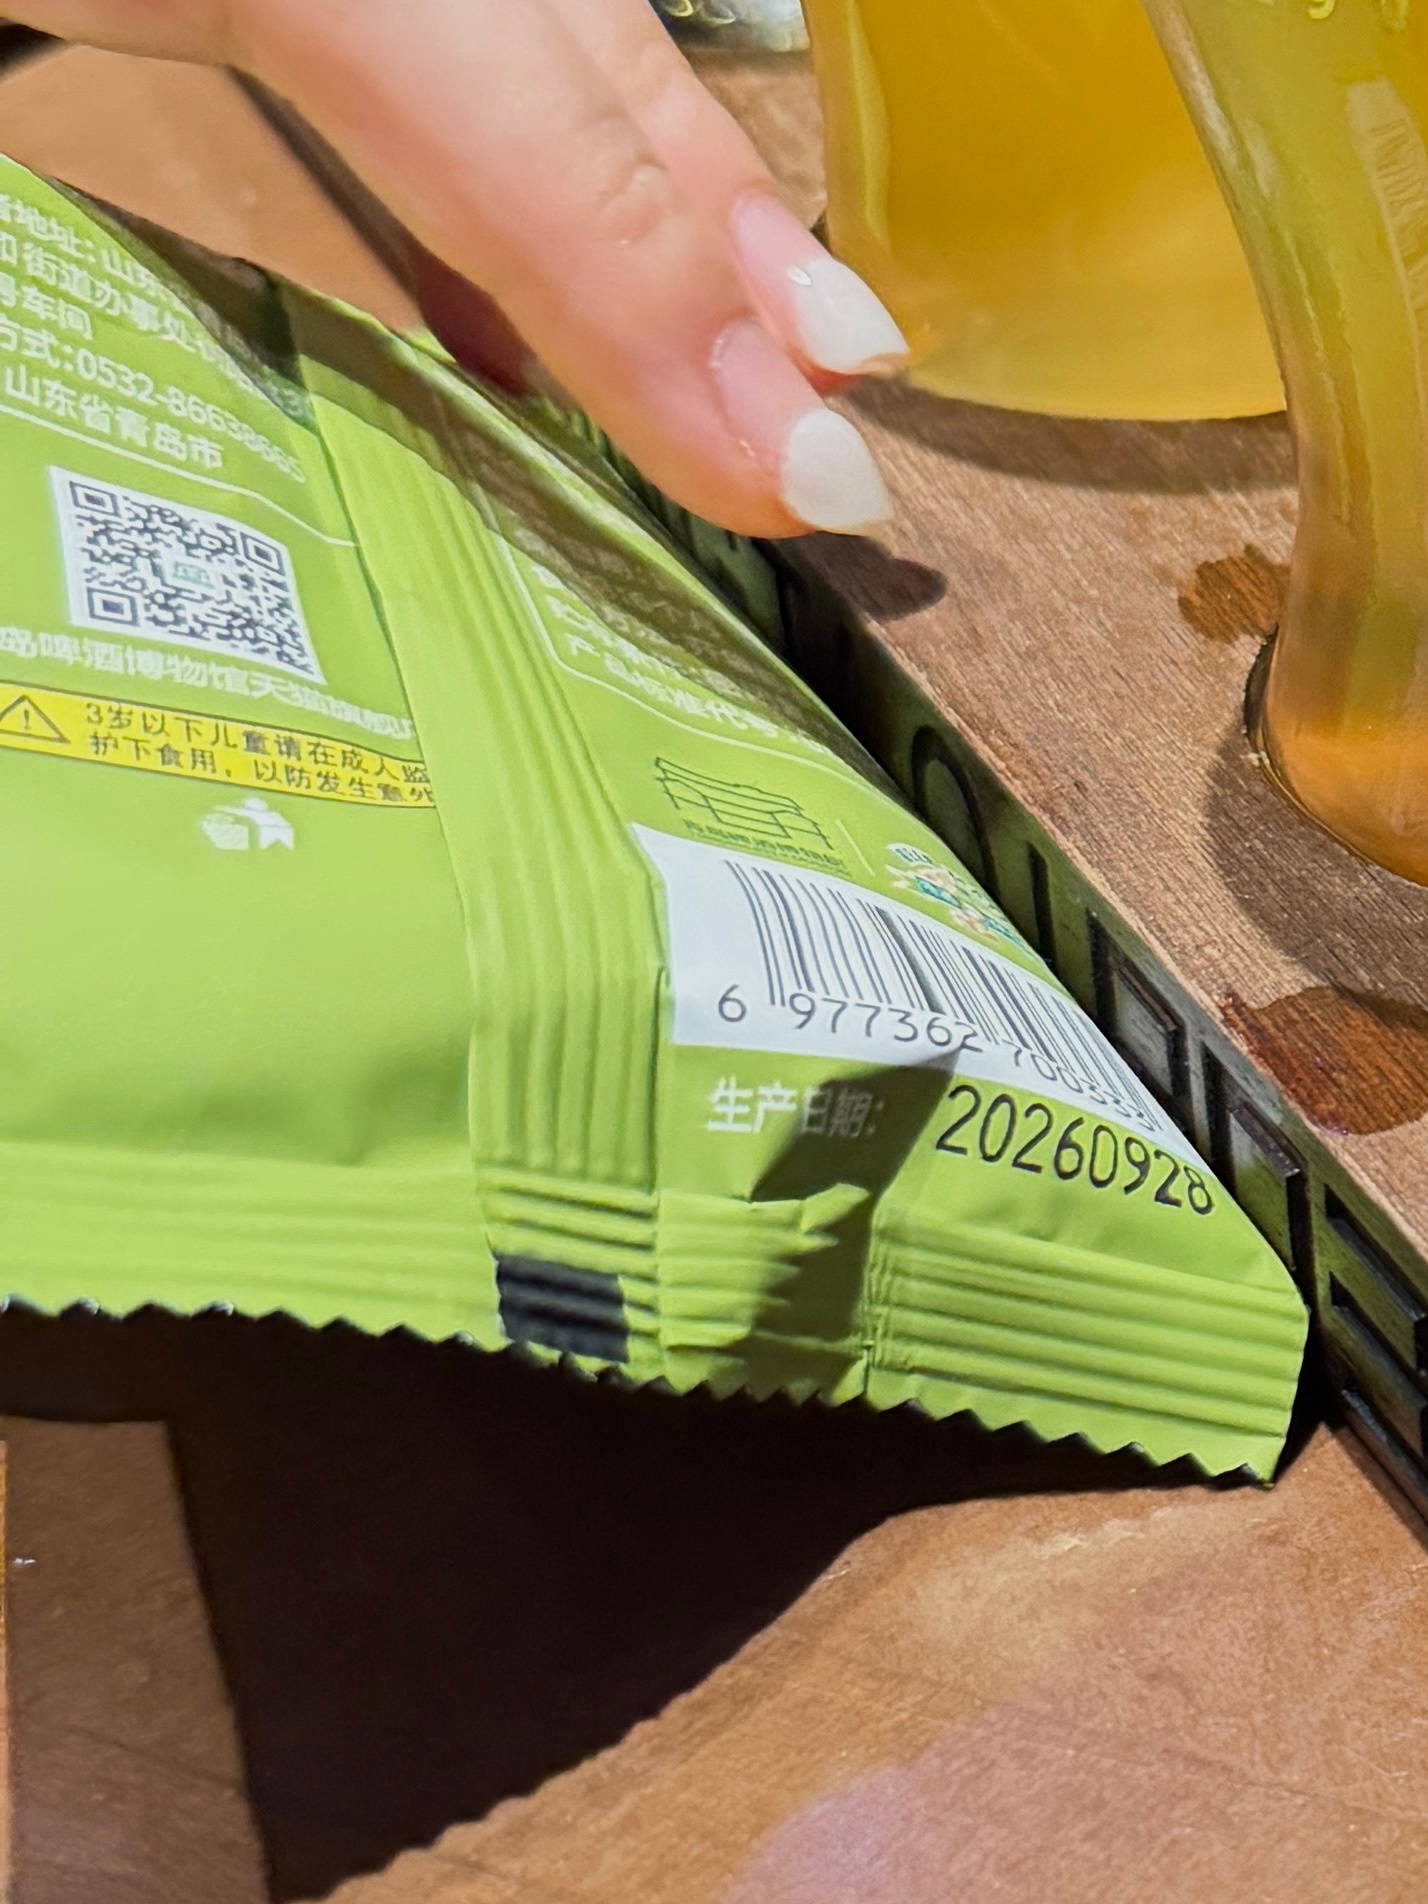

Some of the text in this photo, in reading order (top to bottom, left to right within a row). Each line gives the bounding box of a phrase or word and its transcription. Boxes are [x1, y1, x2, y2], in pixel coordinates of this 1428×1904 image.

[4, 363, 224, 469] 山东省青岛市
[717, 983, 747, 1024] 6
[788, 992, 984, 1054] 977362
[935, 1084, 1215, 1216] 20260928
